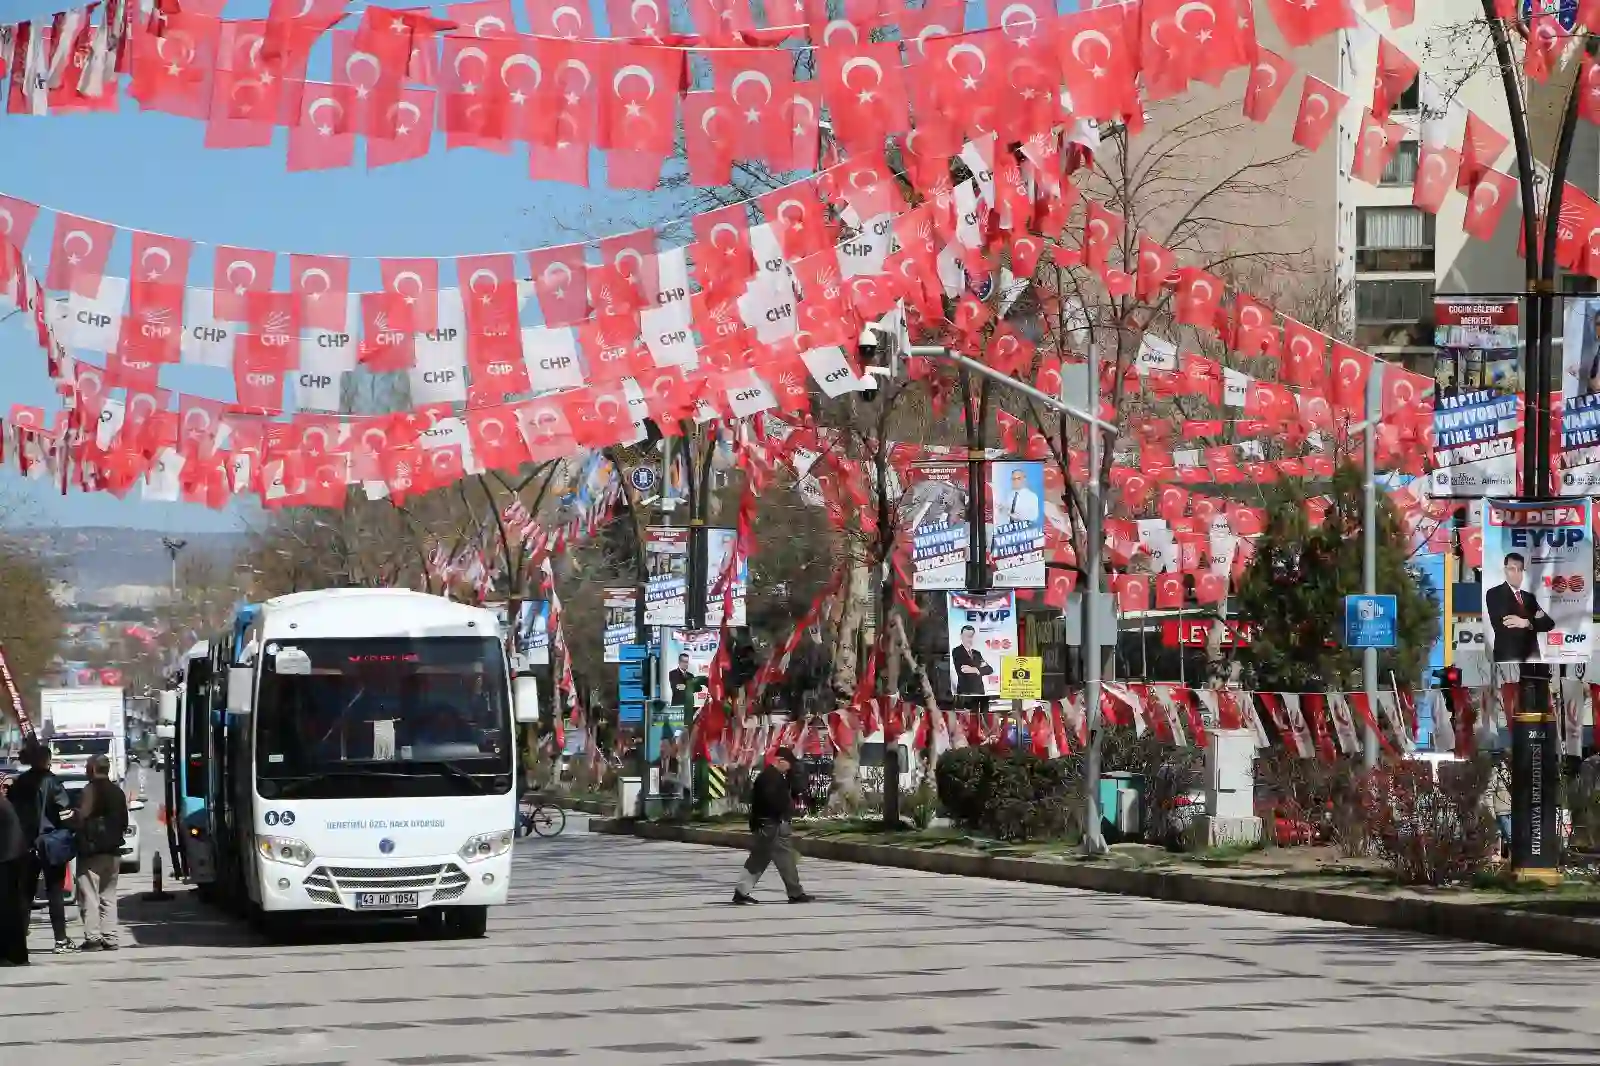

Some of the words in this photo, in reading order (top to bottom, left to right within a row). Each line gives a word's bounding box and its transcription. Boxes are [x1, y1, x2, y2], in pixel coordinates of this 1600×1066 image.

[979, 170, 993, 183] CH
[965, 212, 978, 226] CH
[843, 244, 872, 257] CHP
[657, 287, 685, 305] CHP
[77, 311, 111, 328] CHP
[766, 303, 792, 322] CHP
[142, 324, 171, 337] CHP
[193, 326, 227, 343] CHP
[425, 328, 457, 342] CHP
[716, 322, 738, 336] CHP
[261, 333, 290, 347] CHP
[318, 332, 350, 349] CHP
[376, 333, 404, 345] CHP
[660, 331, 687, 346] CHP
[600, 348, 626, 361] CHP
[487, 364, 513, 375] CHP
[540, 356, 571, 370] CHP
[246, 373, 275, 386] CHP
[300, 374, 331, 389] CHP
[423, 370, 455, 384] CHP
[825, 368, 850, 383] CHP
[736, 389, 762, 401] CHP
[1491, 508, 1520, 525] BU
[1527, 507, 1581, 525] DEFA
[1565, 634, 1587, 643] CHP
[363, 893, 374, 904] 43
[395, 893, 414, 904] 1054
